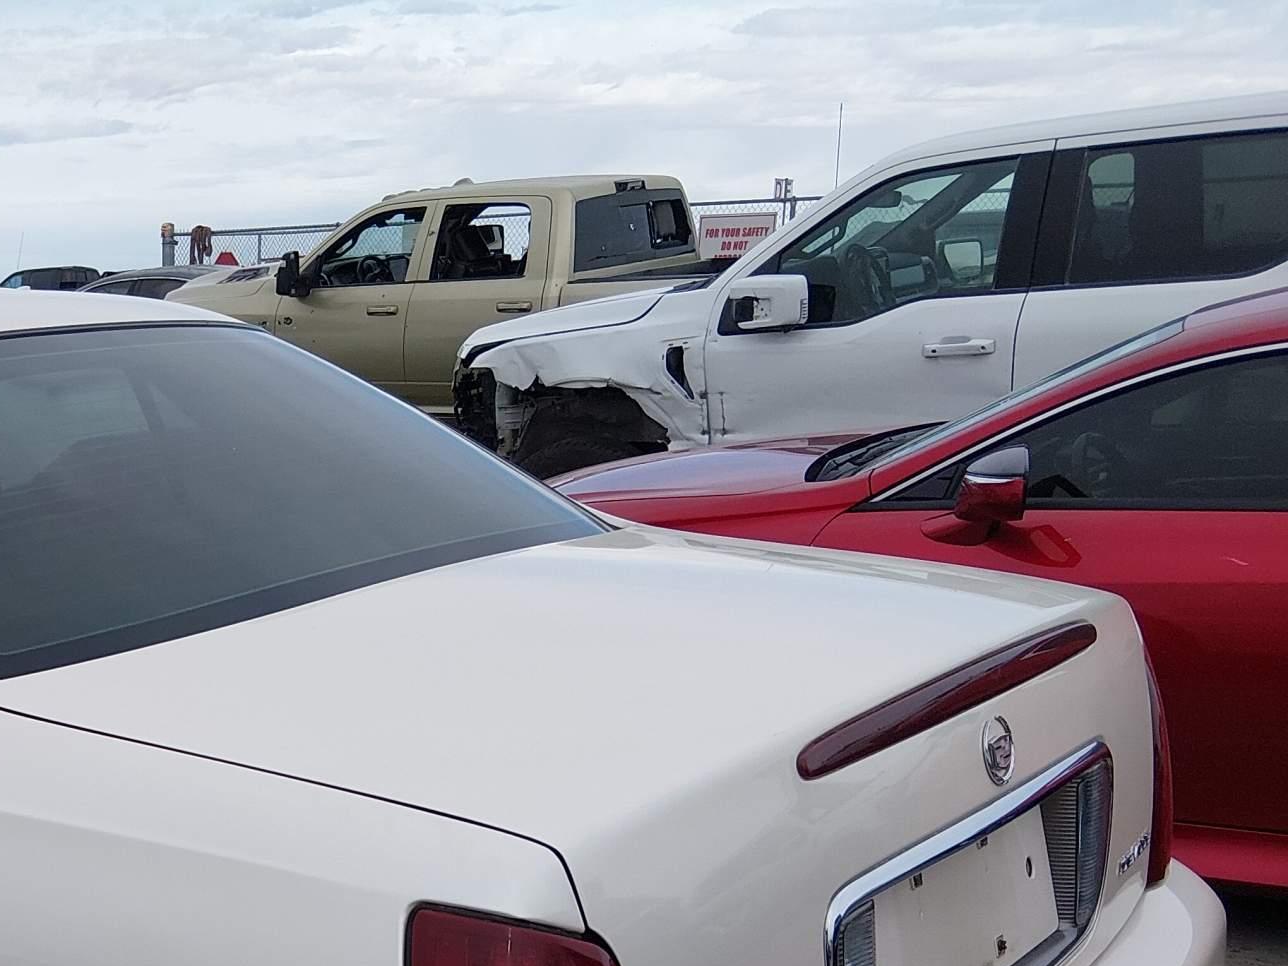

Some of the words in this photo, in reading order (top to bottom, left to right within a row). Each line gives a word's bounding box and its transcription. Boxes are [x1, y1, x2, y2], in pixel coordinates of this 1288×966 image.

[705, 228, 720, 239] FOR
[721, 227, 741, 238] YOUR
[741, 226, 770, 237] SAFETY
[720, 241, 732, 251] DO
[732, 240, 749, 251] NOT
